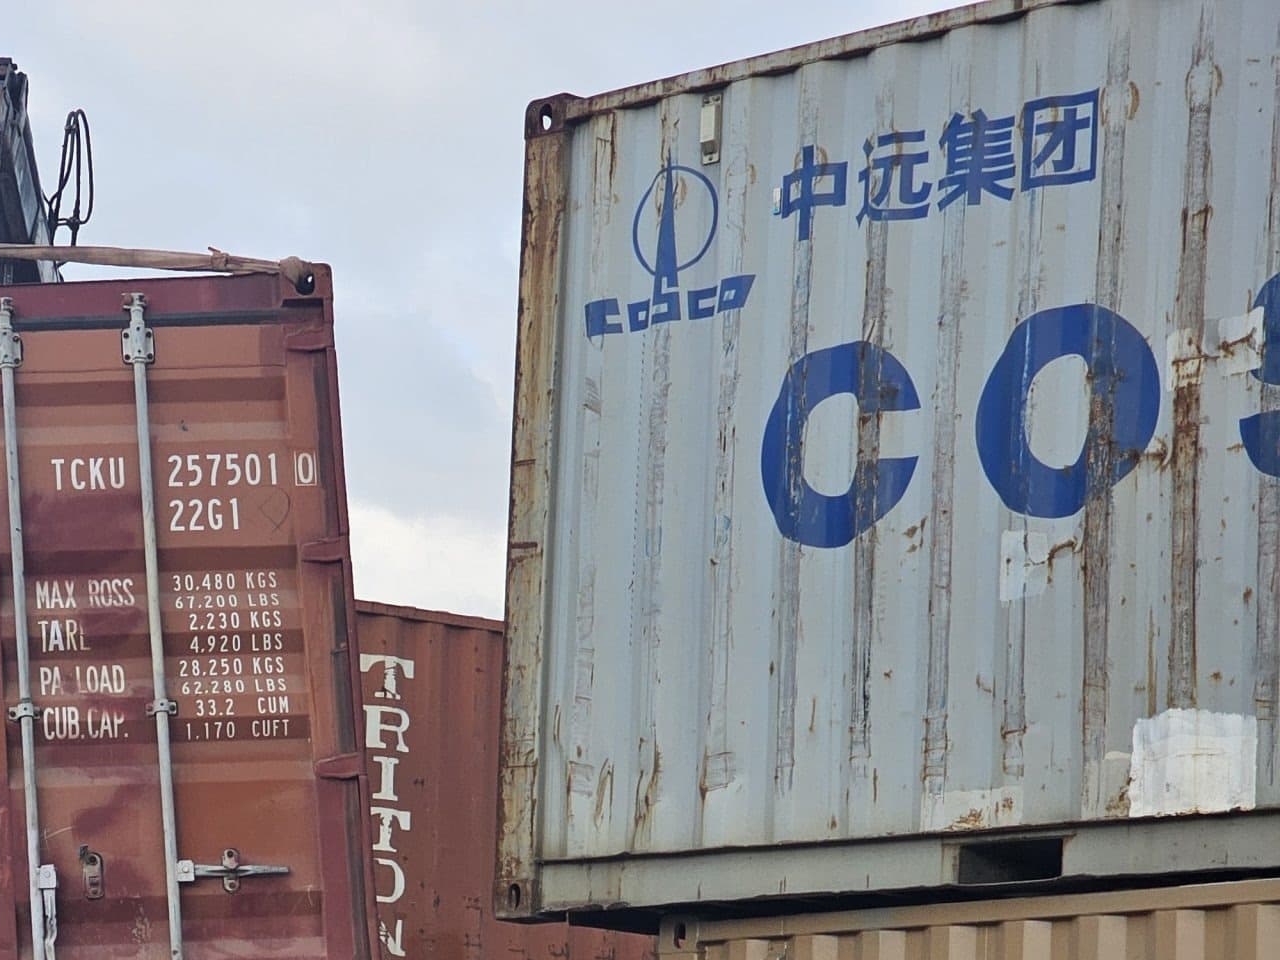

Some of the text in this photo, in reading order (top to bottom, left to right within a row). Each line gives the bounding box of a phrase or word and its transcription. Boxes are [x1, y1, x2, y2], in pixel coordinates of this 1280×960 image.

[781, 87, 1100, 241] 中远集团
[585, 275, 756, 337] COSCO
[761, 274, 1280, 549] CO
[51, 452, 314, 491] TCKU 257501 0
[169, 498, 240, 532] 22G1
[246, 572, 277, 589] KGS
[35, 580, 77, 609] MAX
[248, 593, 280, 607] LBS
[250, 611, 282, 628] KGS
[251, 633, 283, 651] LBS
[253, 657, 285, 675] KGS
[255, 678, 287, 693] LBS
[196, 696, 289, 717] 33.2 CUM
[252, 719, 290, 738] CUFT
